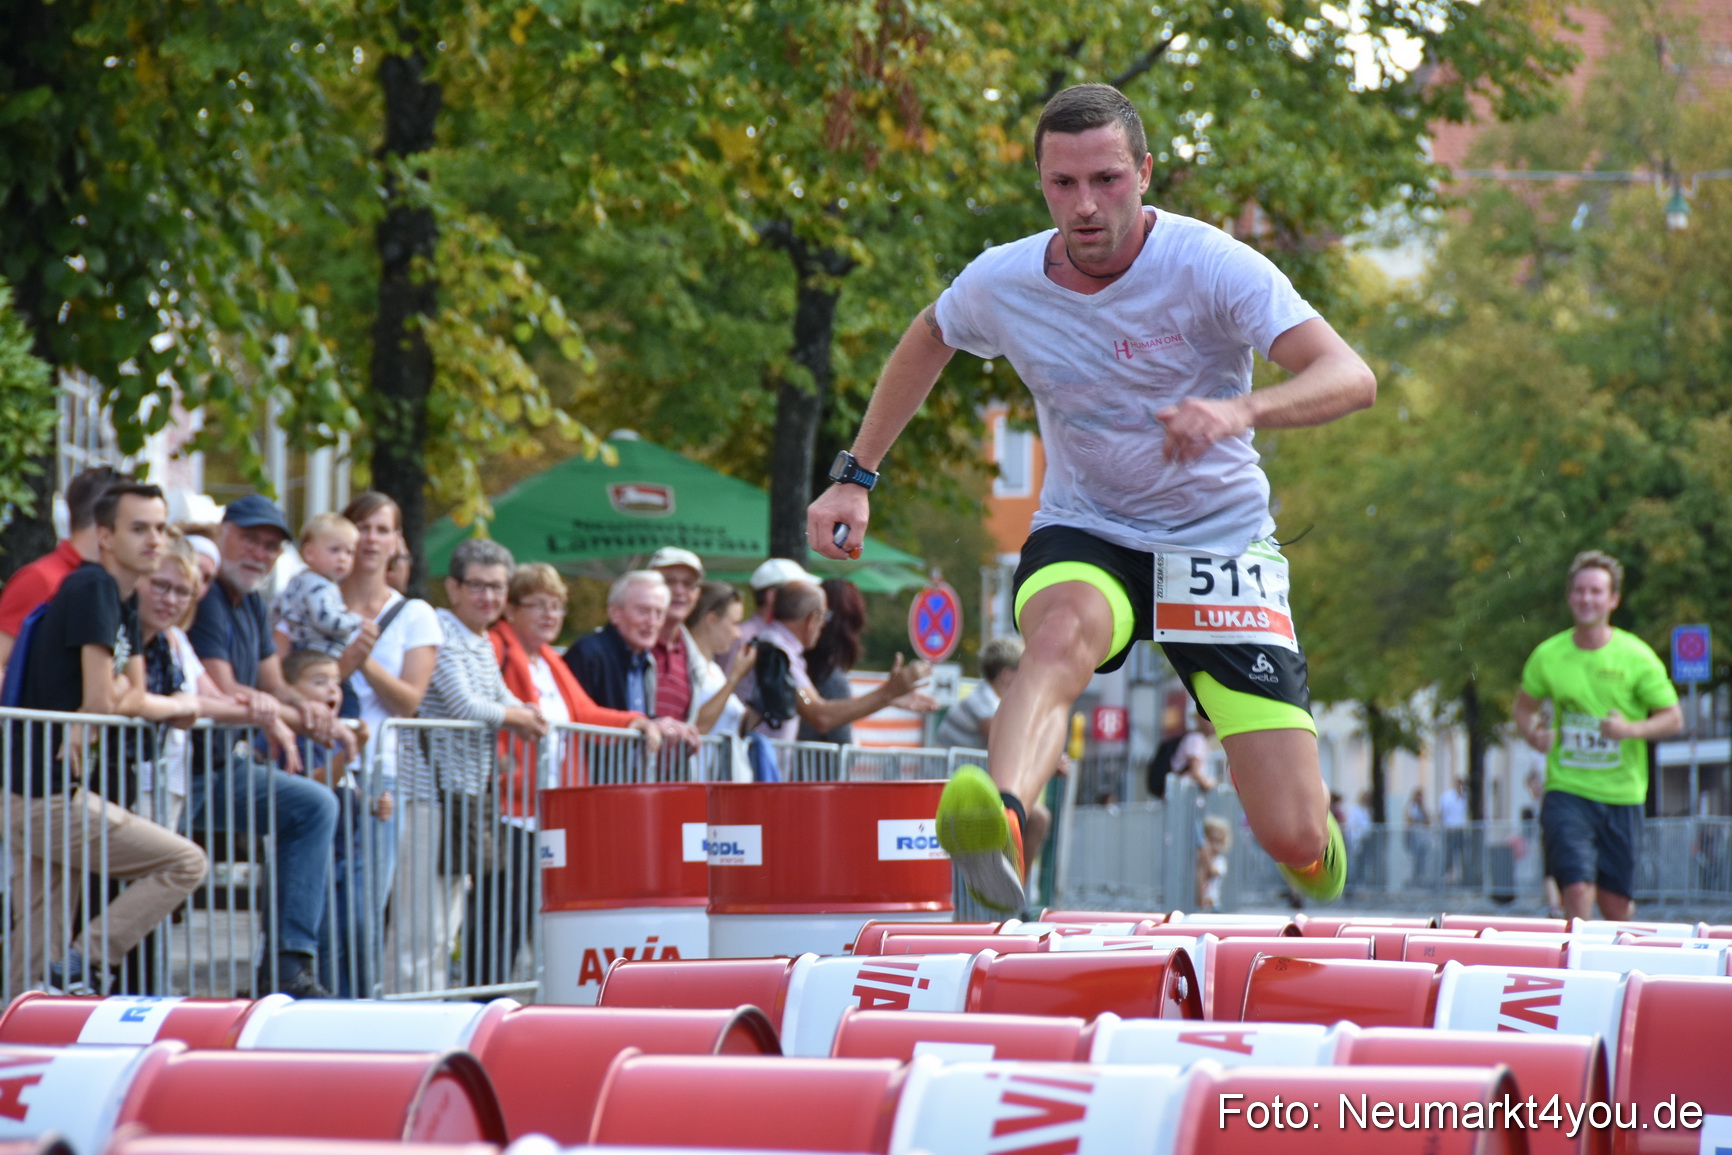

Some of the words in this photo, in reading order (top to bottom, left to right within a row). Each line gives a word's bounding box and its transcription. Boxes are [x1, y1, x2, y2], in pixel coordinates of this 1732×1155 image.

[1130, 338, 1163, 349] HUMAN
[1163, 333, 1184, 344] ONE
[1189, 557, 1267, 599] 511
[1194, 609, 1271, 629] LUKAS
[1248, 673, 1279, 684] odlo
